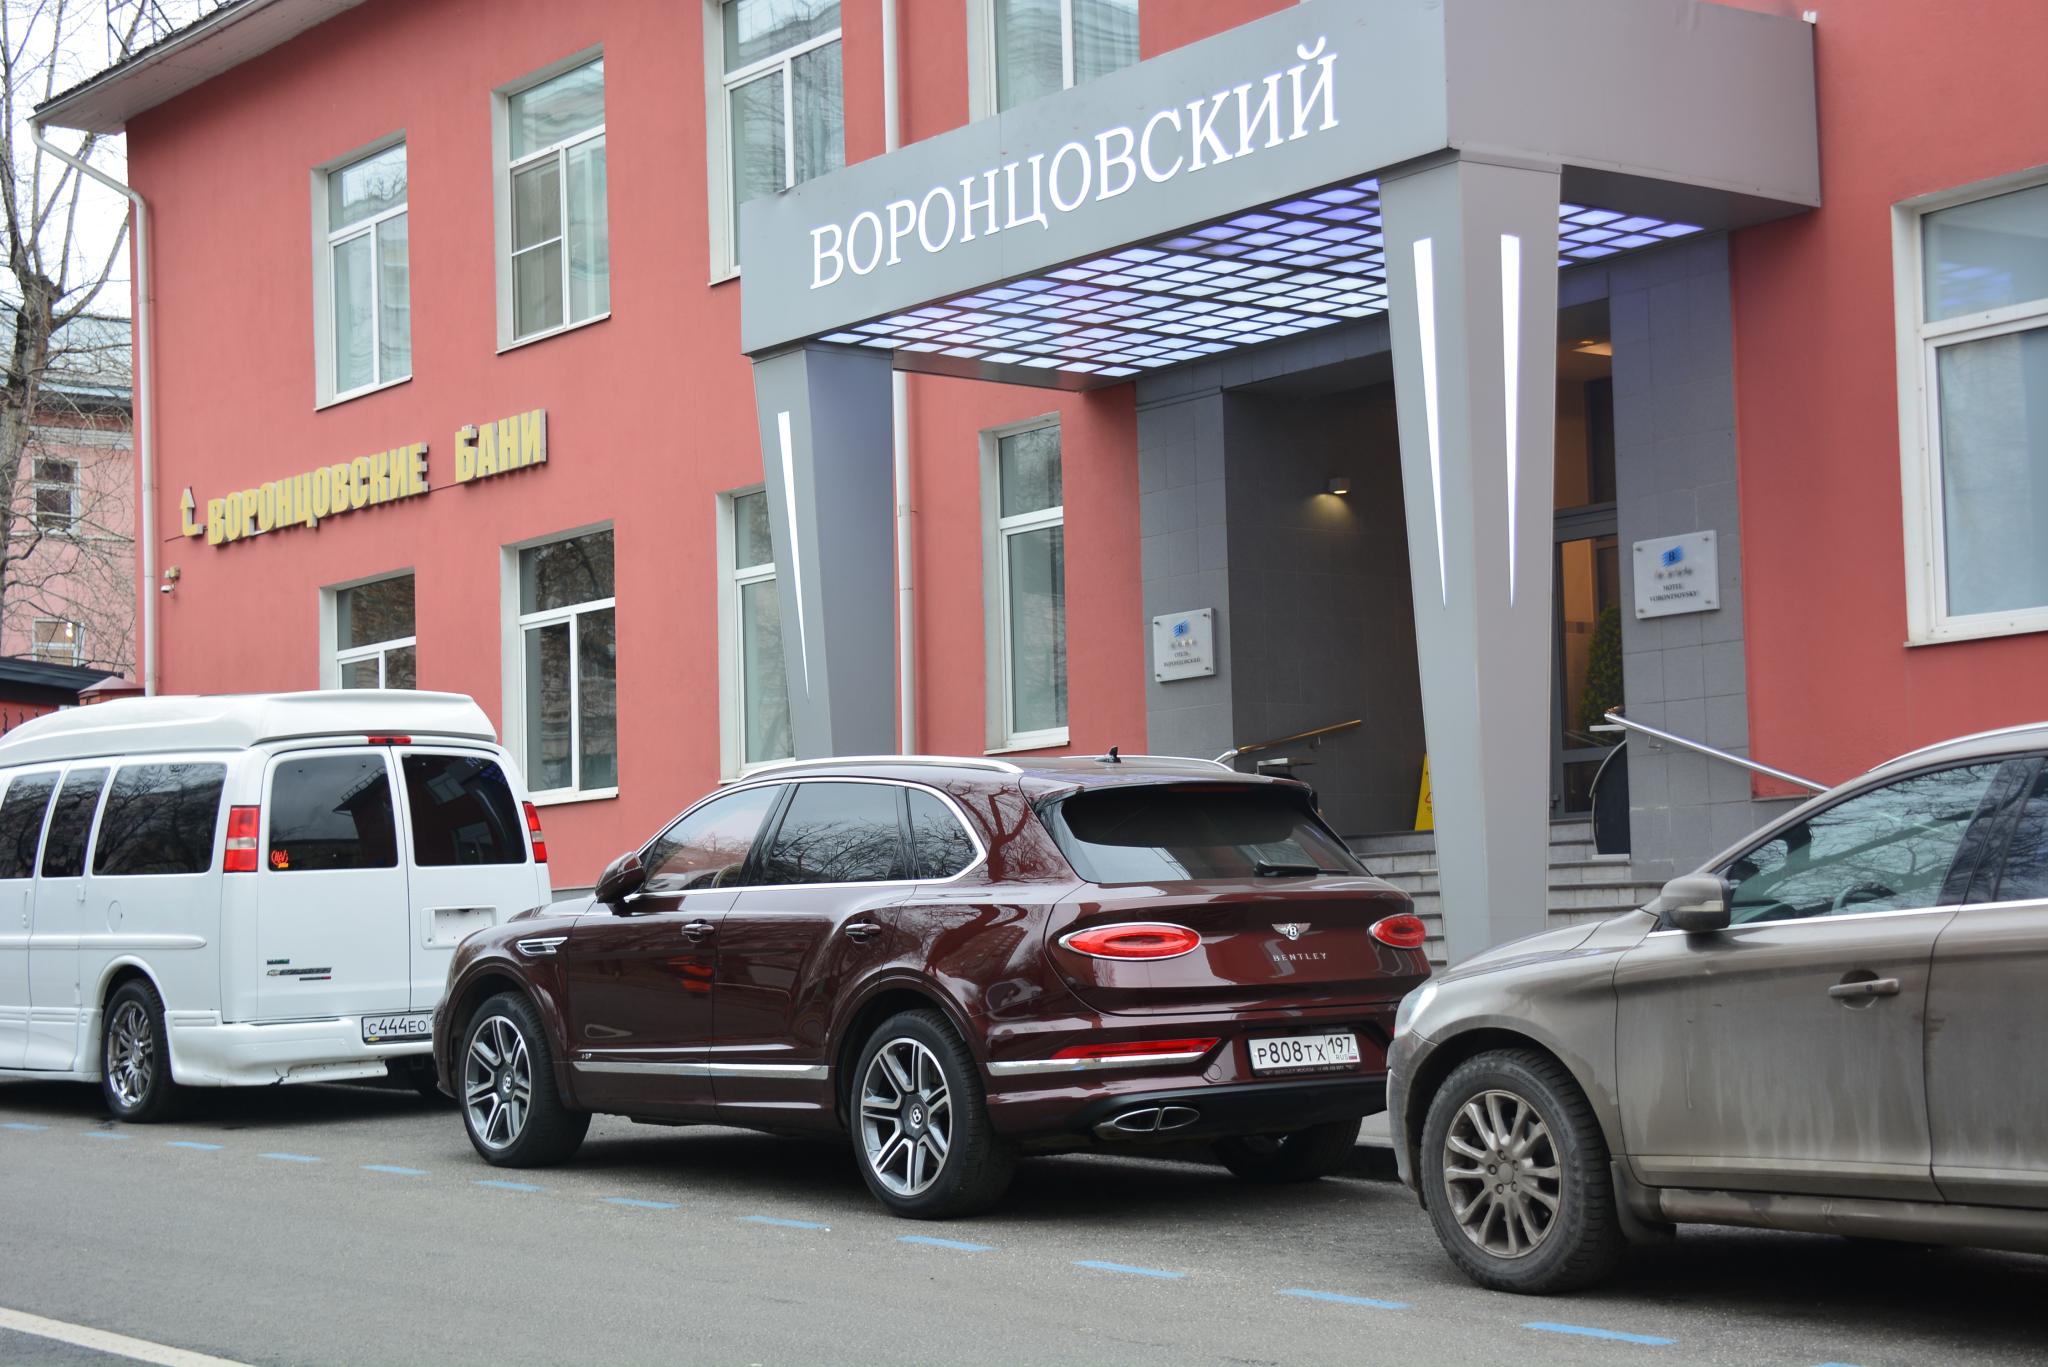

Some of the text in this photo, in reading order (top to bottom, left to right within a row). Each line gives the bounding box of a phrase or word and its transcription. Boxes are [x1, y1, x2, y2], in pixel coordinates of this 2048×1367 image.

[808, 35, 1341, 291] ВОРОНЦОВСКИЙ
[207, 408, 547, 546] ВОРОНЦОВСКИЕ БАНИ
[1272, 952, 1328, 963] BENTLEY
[1327, 1036, 1351, 1054] 197
